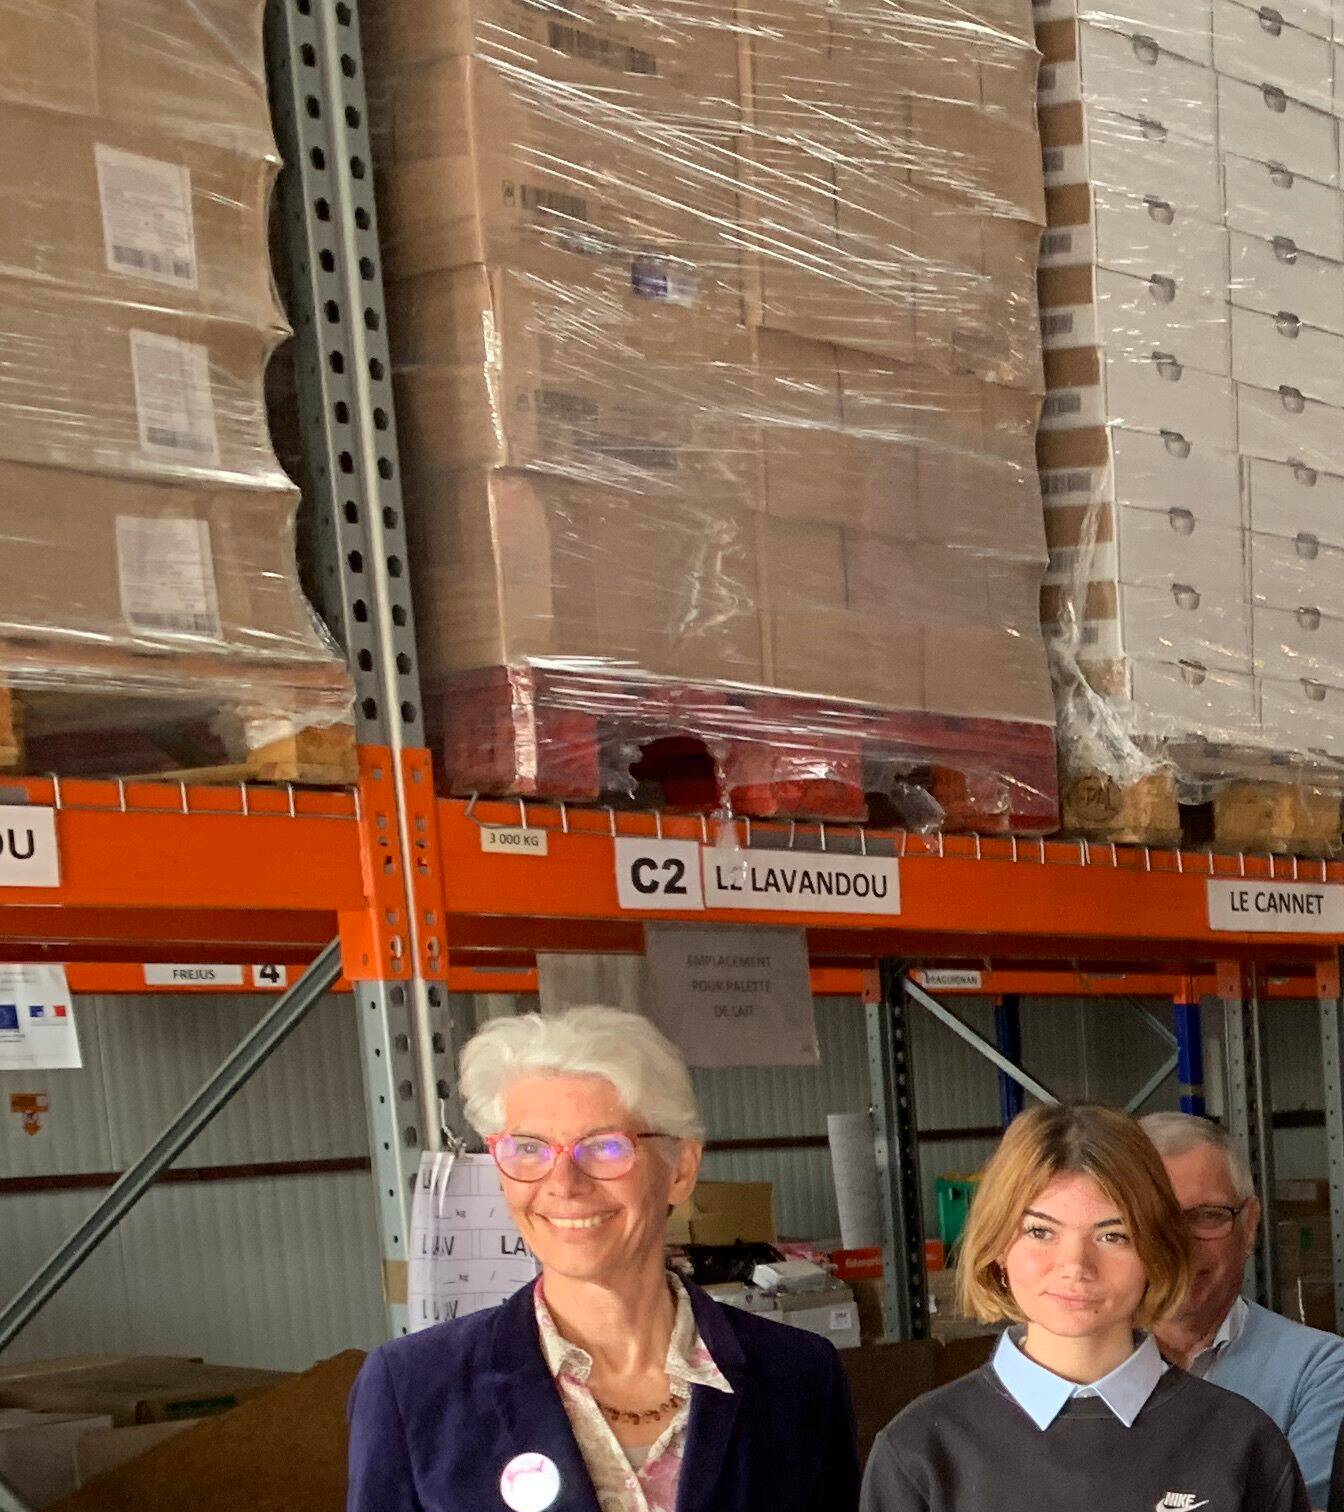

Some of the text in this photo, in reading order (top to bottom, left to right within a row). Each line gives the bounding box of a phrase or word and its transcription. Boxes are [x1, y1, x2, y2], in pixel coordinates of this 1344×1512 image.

[0, 829, 35, 860] U
[523, 836, 539, 847] KG
[631, 858, 687, 895] C2
[752, 868, 888, 898] LAVANDOU
[1230, 891, 1324, 915] LE CANNET
[173, 964, 280, 983] FREJUS 4
[692, 979, 771, 994] POUR PALETTE
[501, 1235, 535, 1257] LA
[1164, 1491, 1197, 1508] NIKE
